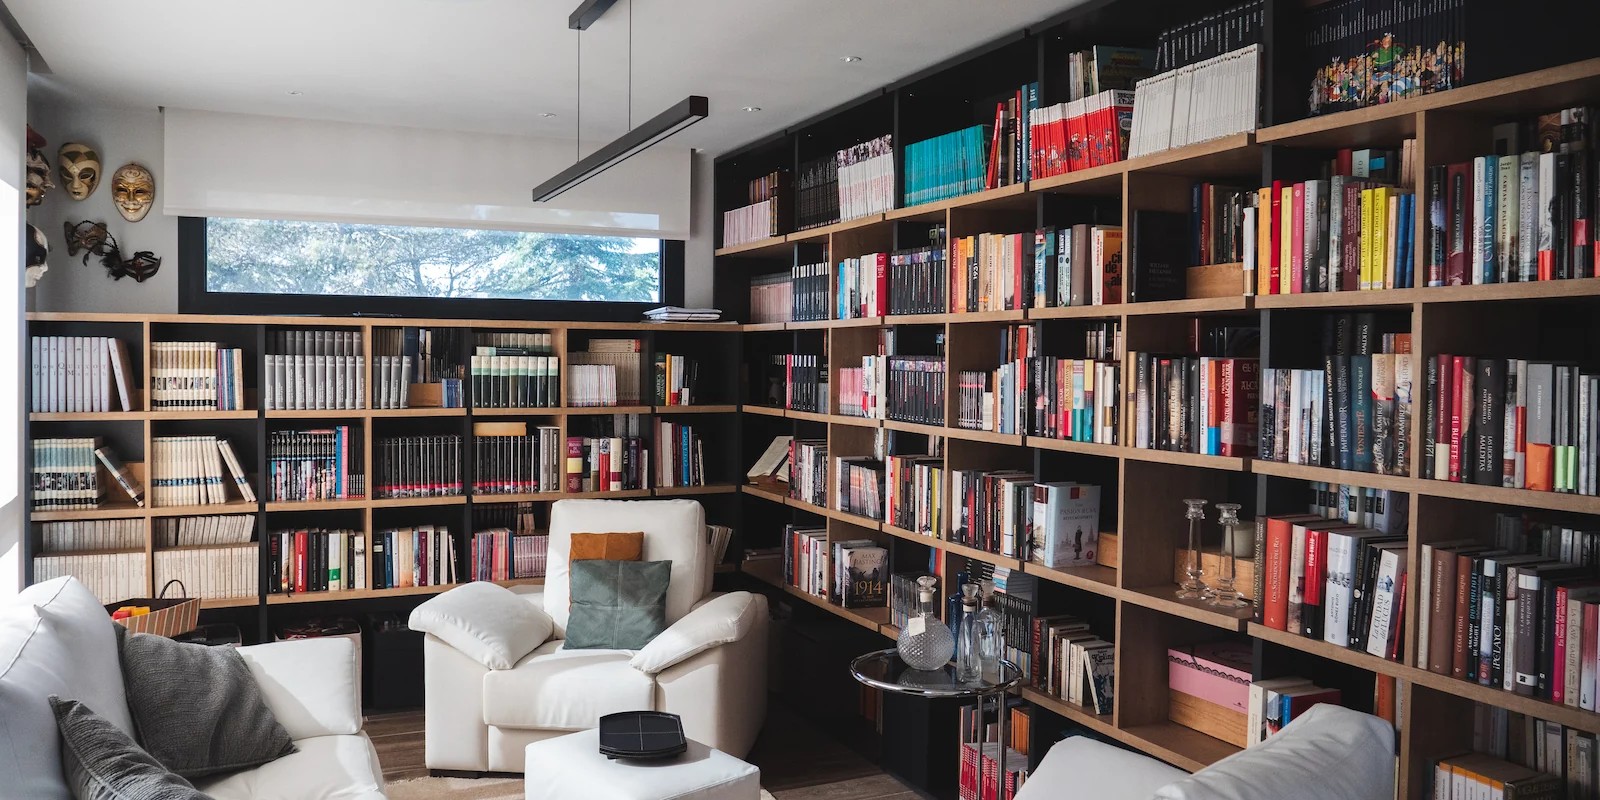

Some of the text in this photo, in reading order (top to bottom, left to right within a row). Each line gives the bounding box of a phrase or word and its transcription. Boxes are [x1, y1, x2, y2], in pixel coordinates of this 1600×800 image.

[1105, 261, 1117, 273] de
[1361, 325, 1369, 355] MALDITAS
[1338, 405, 1348, 453] IMPERATOR
[1376, 401, 1384, 434] RAMÍREZ
[1397, 403, 1406, 437] RAMÍREZ
[1355, 411, 1364, 456] PONIENTE
[1425, 438, 1434, 458] 1212
[1450, 416, 1459, 460] EL BUFETE
[1397, 442, 1405, 467] PEDRO
[1060, 507, 1081, 515] PASIÓN
[1271, 559, 1279, 587] SOLDADOS
[1470, 572, 1478, 602] QUIJOTE
[854, 580, 883, 596] 1914
[1372, 594, 1384, 640] La CIUDAD
[1381, 599, 1390, 628] LUCUS
[1570, 608, 1577, 618] LA
[1493, 624, 1502, 671] ¡PELAYO!
[1559, 639, 1565, 647] En
